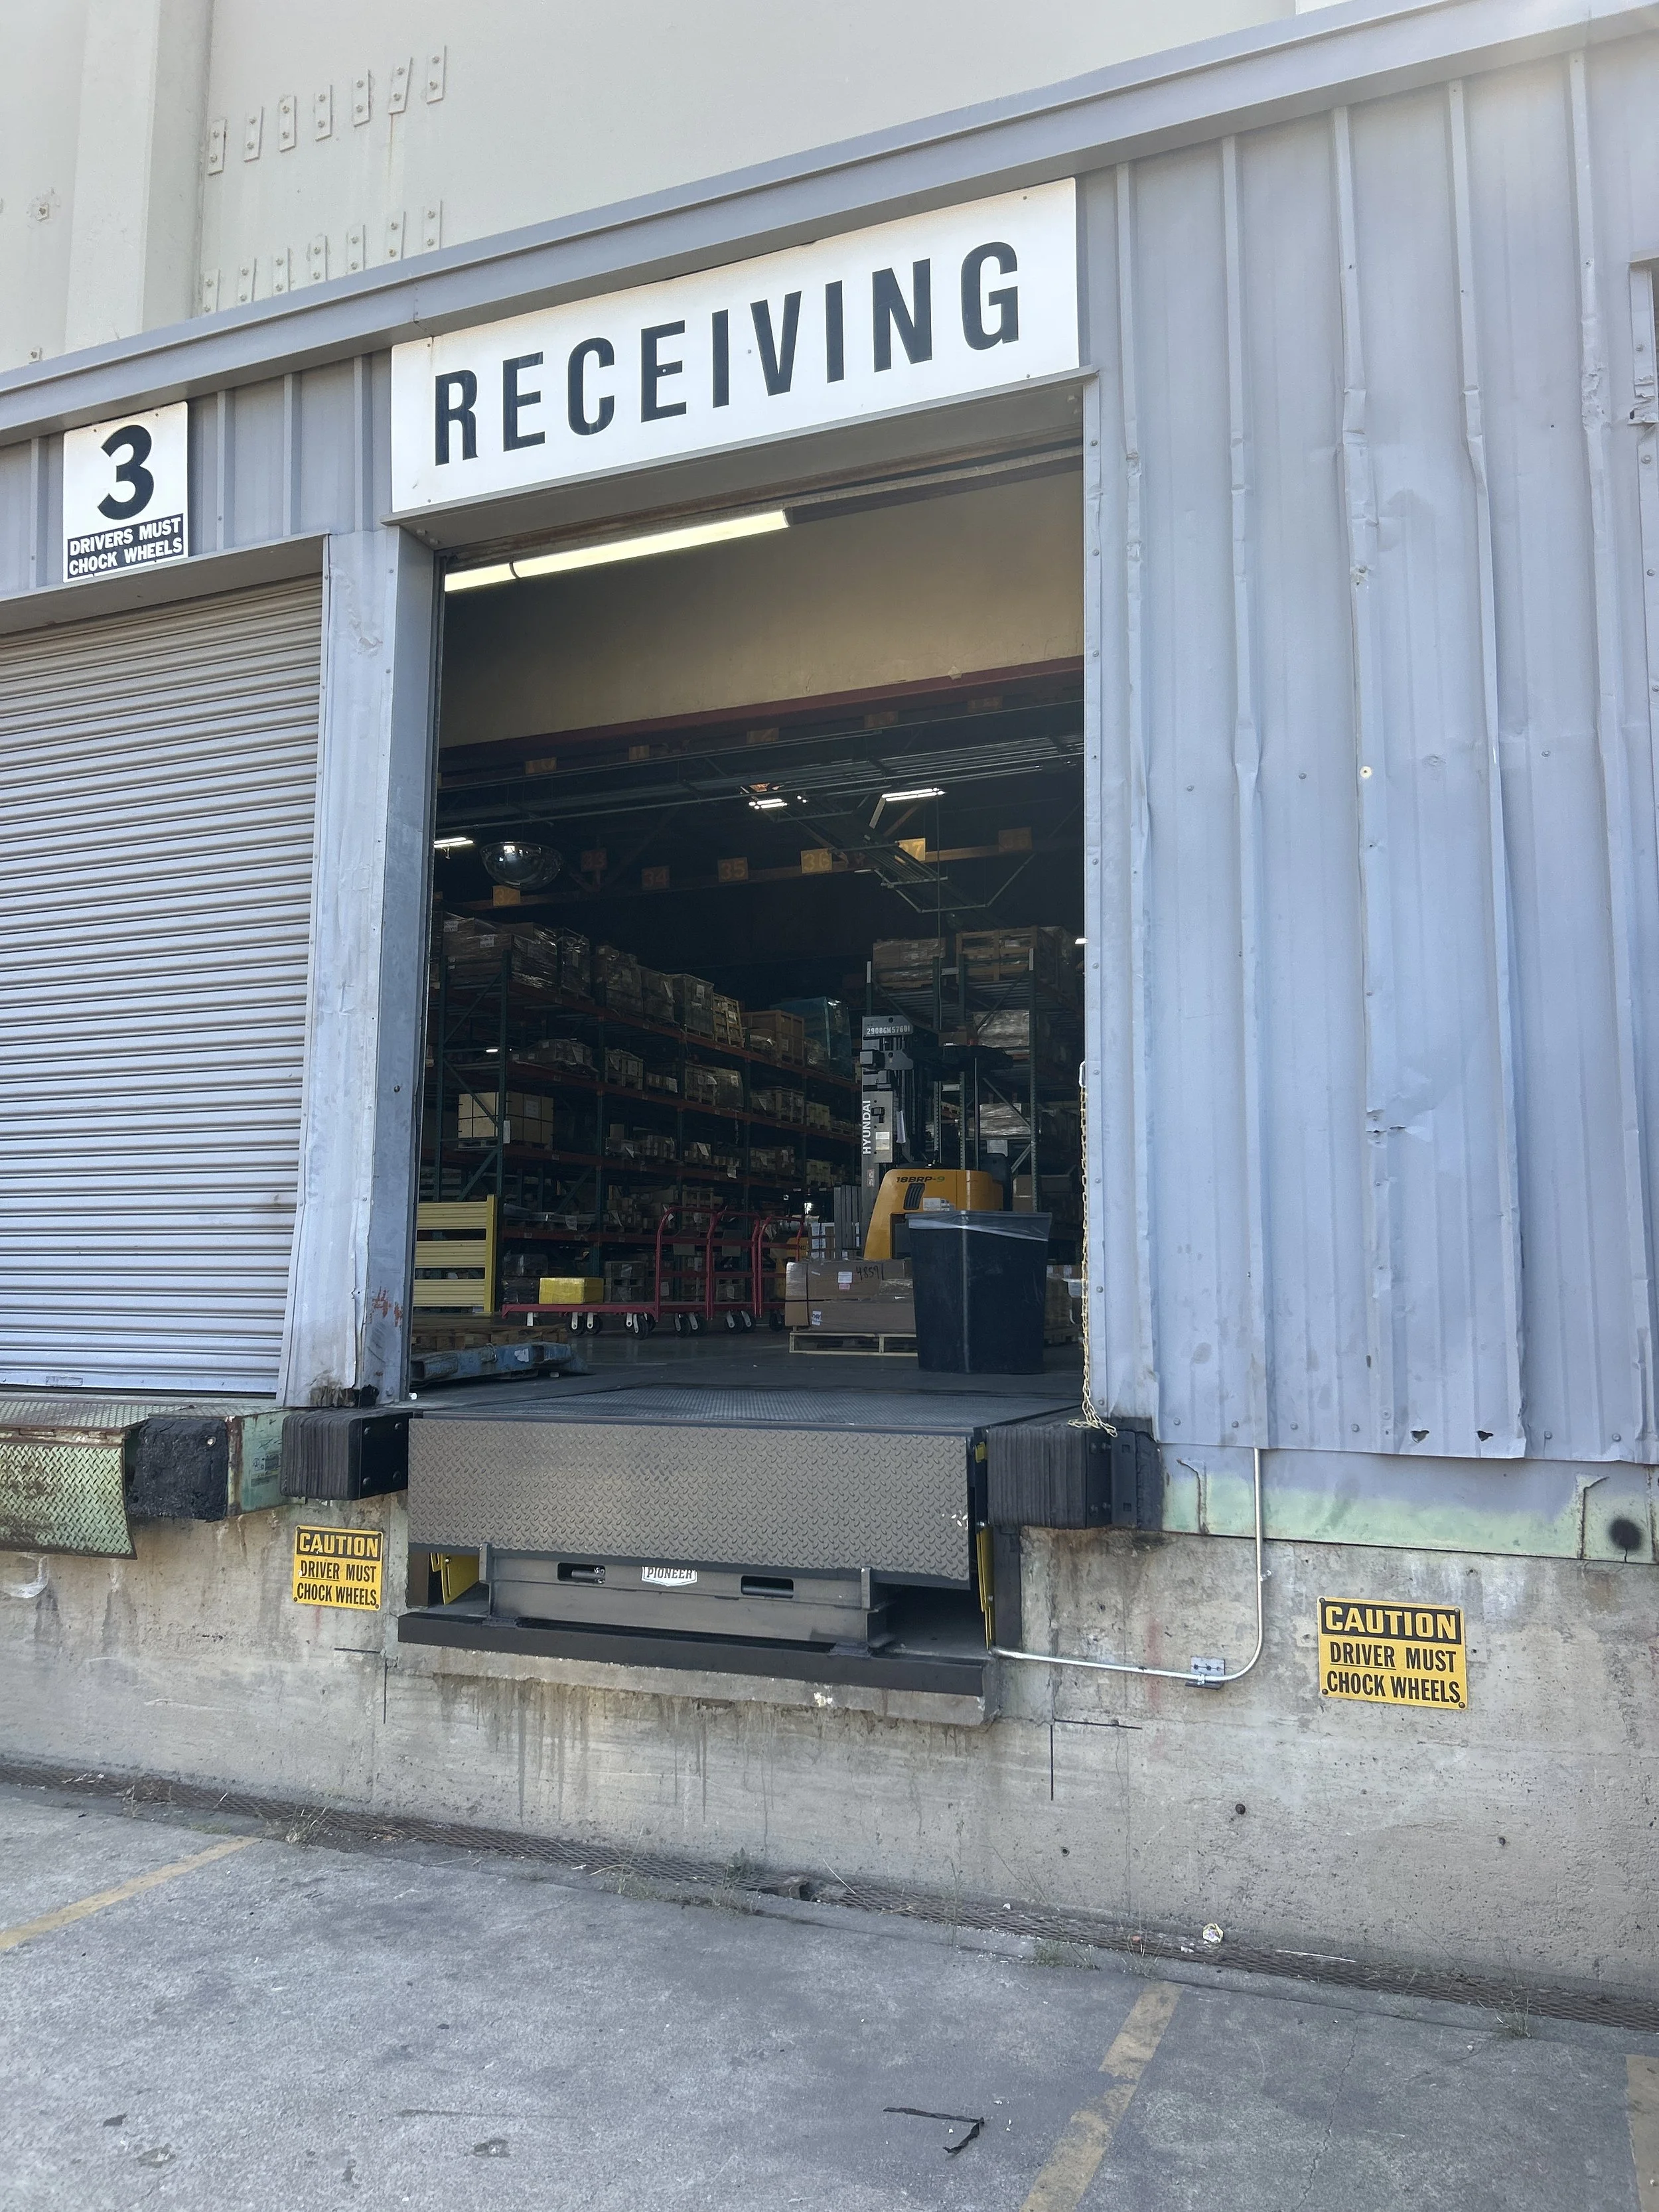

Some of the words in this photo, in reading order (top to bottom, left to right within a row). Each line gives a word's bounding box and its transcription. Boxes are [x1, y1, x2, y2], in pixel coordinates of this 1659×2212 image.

[435, 241, 1019, 466] RECEIVING
[98, 425, 154, 520] 3
[70, 528, 133, 556] DRIVERS
[139, 517, 181, 541] MUST
[69, 552, 118, 575] CHOCK
[124, 538, 182, 564] WHEELS
[721, 859, 747, 881] 35
[803, 849, 831, 871] 36
[643, 868, 670, 887] 34
[299, 1532, 378, 1558] CAUTION
[301, 1560, 340, 1580] DRIVER
[346, 1564, 376, 1583] MUST
[646, 1567, 692, 1579] PIONEER
[297, 1582, 332, 1602] CHOCK
[335, 1585, 377, 1606] WHEELS
[1325, 1606, 1456, 1639] CAUTION
[1330, 1641, 1396, 1668] DRIVER
[1406, 1647, 1457, 1672] MUST
[1327, 1670, 1386, 1696] CHOCK
[1390, 1675, 1461, 1704] WHEELS
